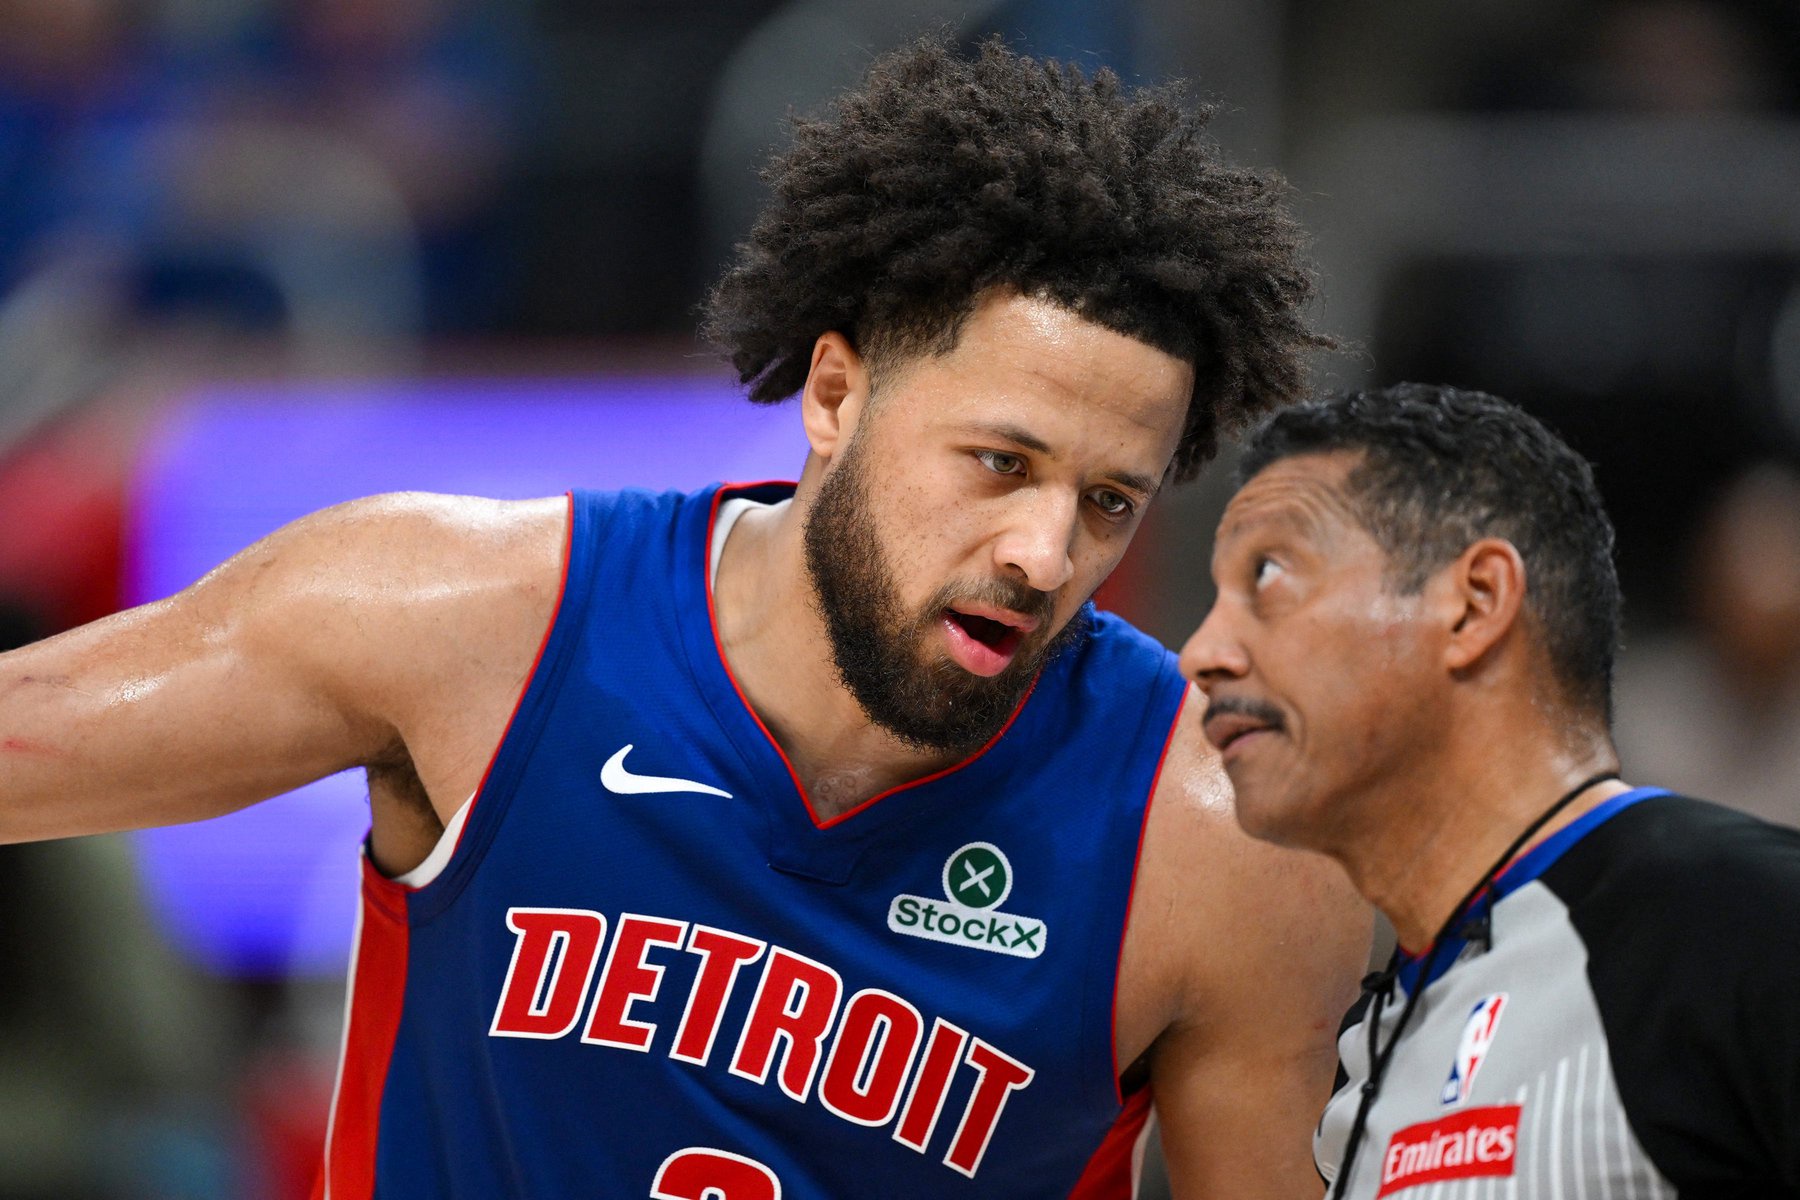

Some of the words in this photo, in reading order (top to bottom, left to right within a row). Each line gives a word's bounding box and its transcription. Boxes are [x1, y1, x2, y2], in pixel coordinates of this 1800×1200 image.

[895, 899, 1041, 952] StockX
[489, 907, 1035, 1179] DETROIT
[1383, 1125, 1516, 1185] Emirates
